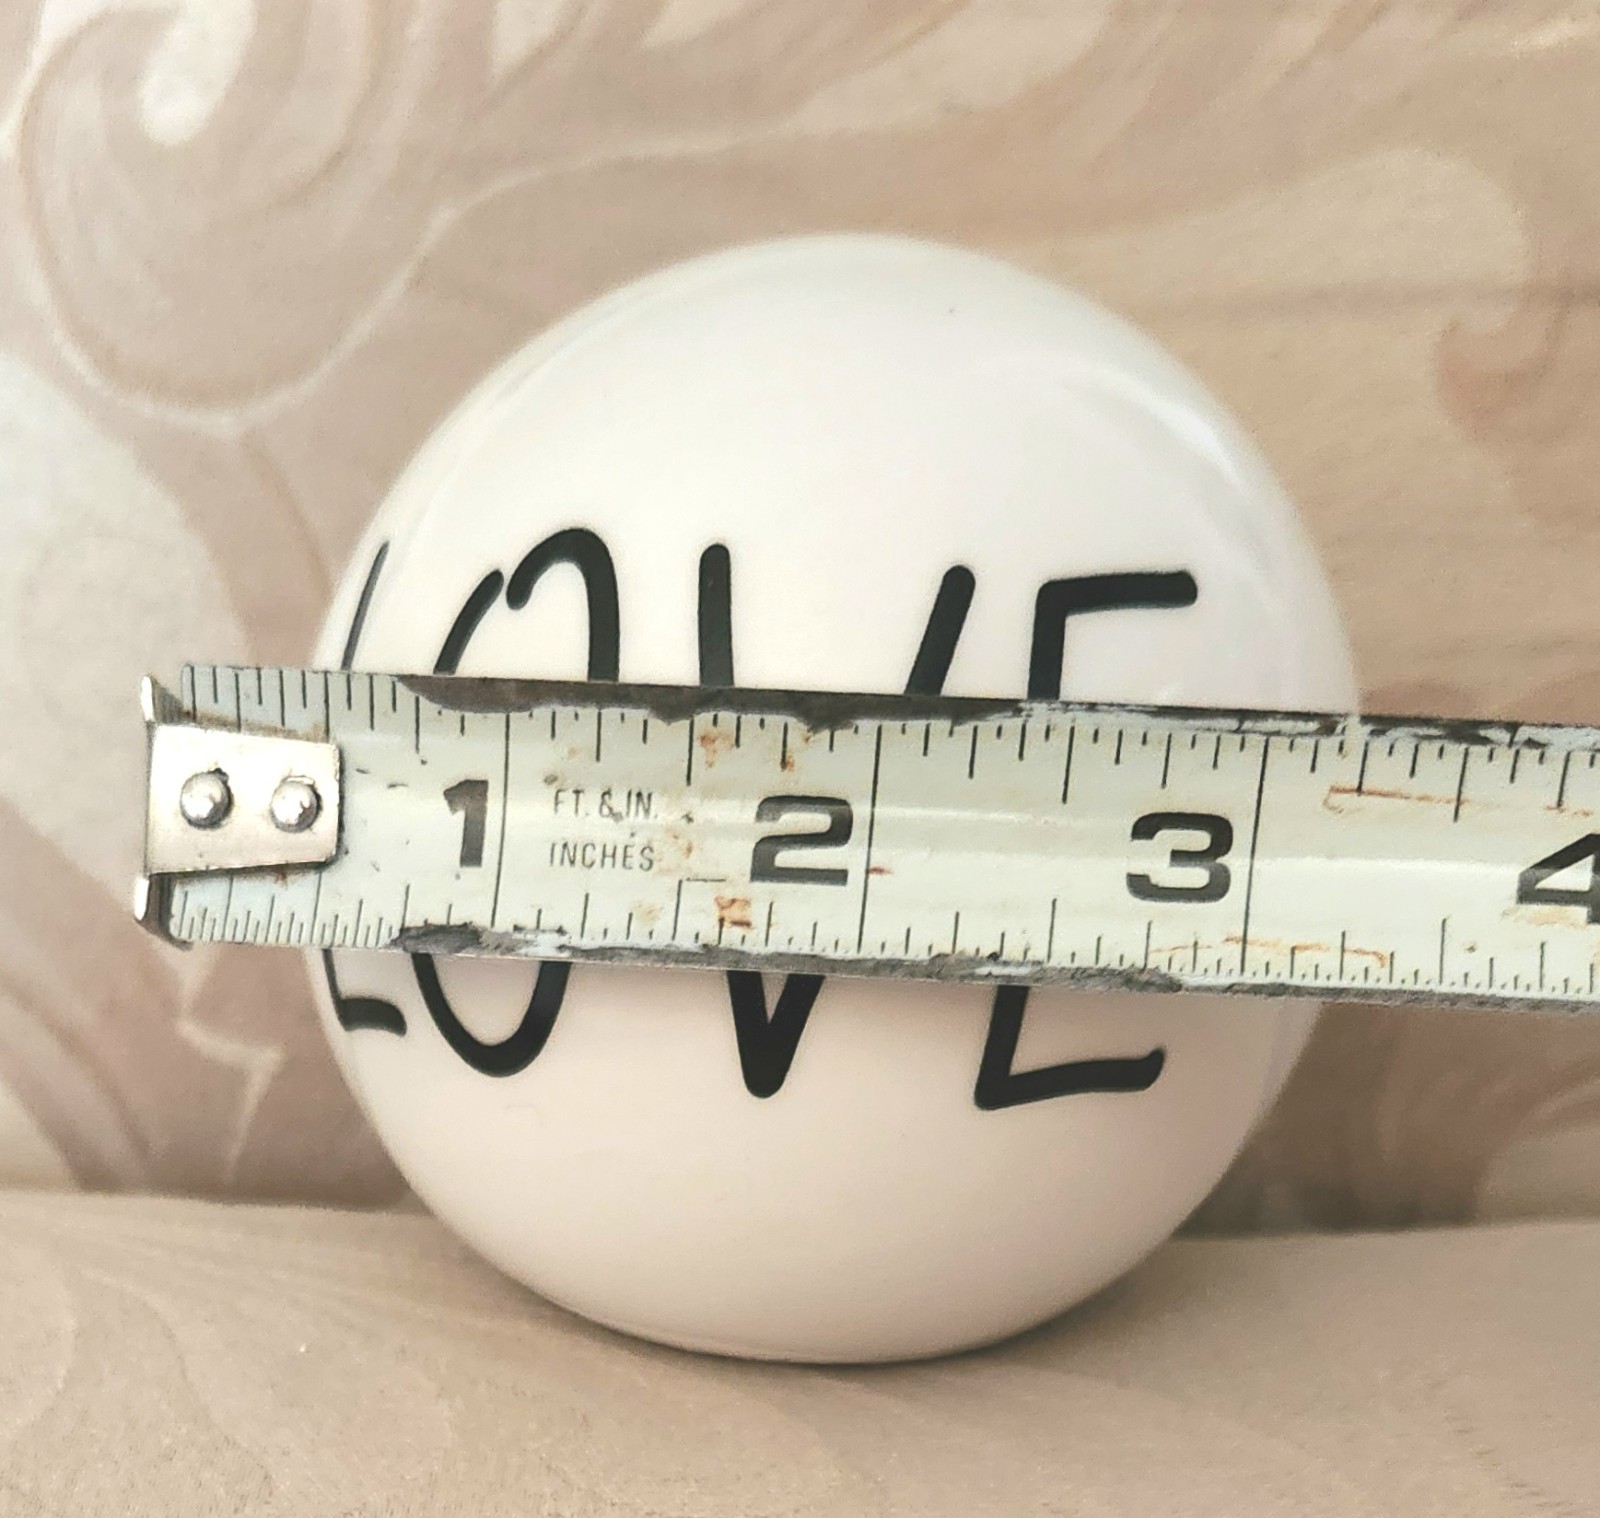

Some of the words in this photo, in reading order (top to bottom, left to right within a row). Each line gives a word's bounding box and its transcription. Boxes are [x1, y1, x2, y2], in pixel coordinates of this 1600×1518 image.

[443, 779, 489, 868] 1
[549, 841, 655, 872] INCHES
[750, 795, 854, 887] 2
[1126, 812, 1234, 904] 3
[1516, 833, 1600, 924] 4
